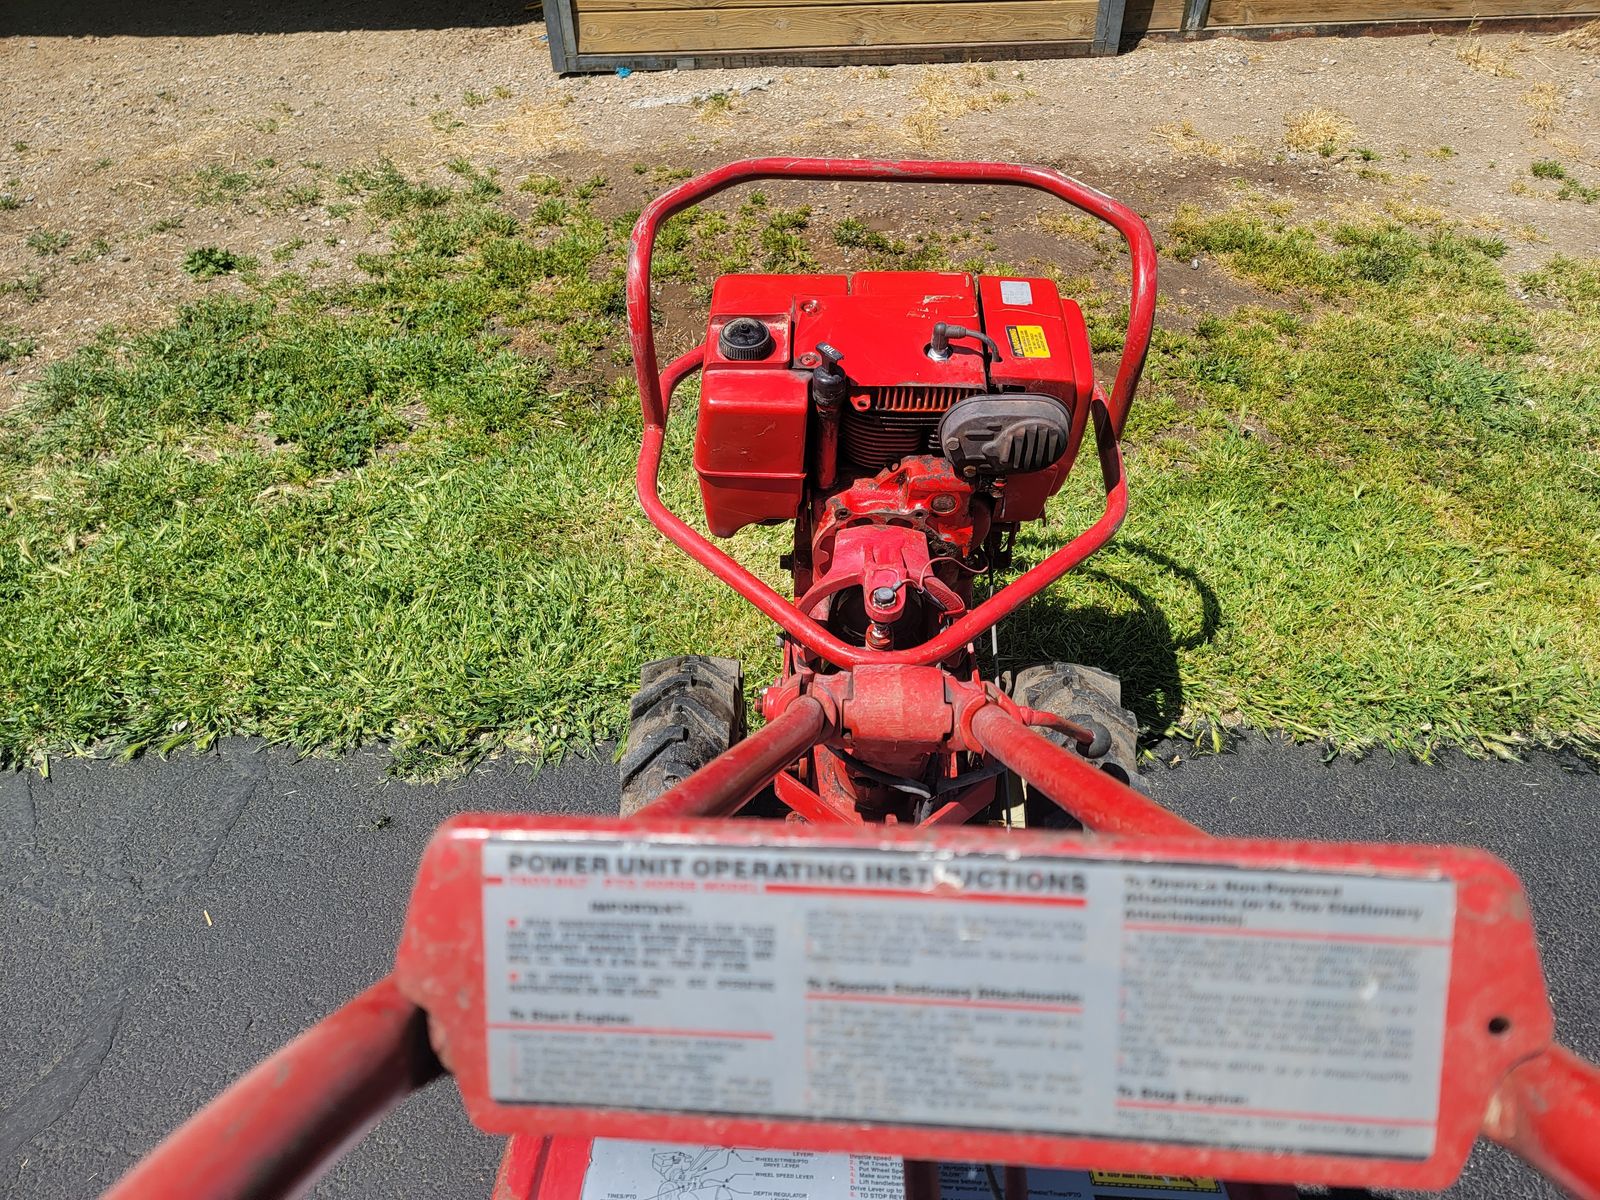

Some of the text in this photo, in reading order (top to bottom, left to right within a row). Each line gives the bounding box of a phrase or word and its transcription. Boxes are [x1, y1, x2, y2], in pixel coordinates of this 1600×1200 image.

[823, 345, 835, 355] OIL
[508, 854, 1087, 892] POWER UNIT OPERATING INSTUCTIONS
